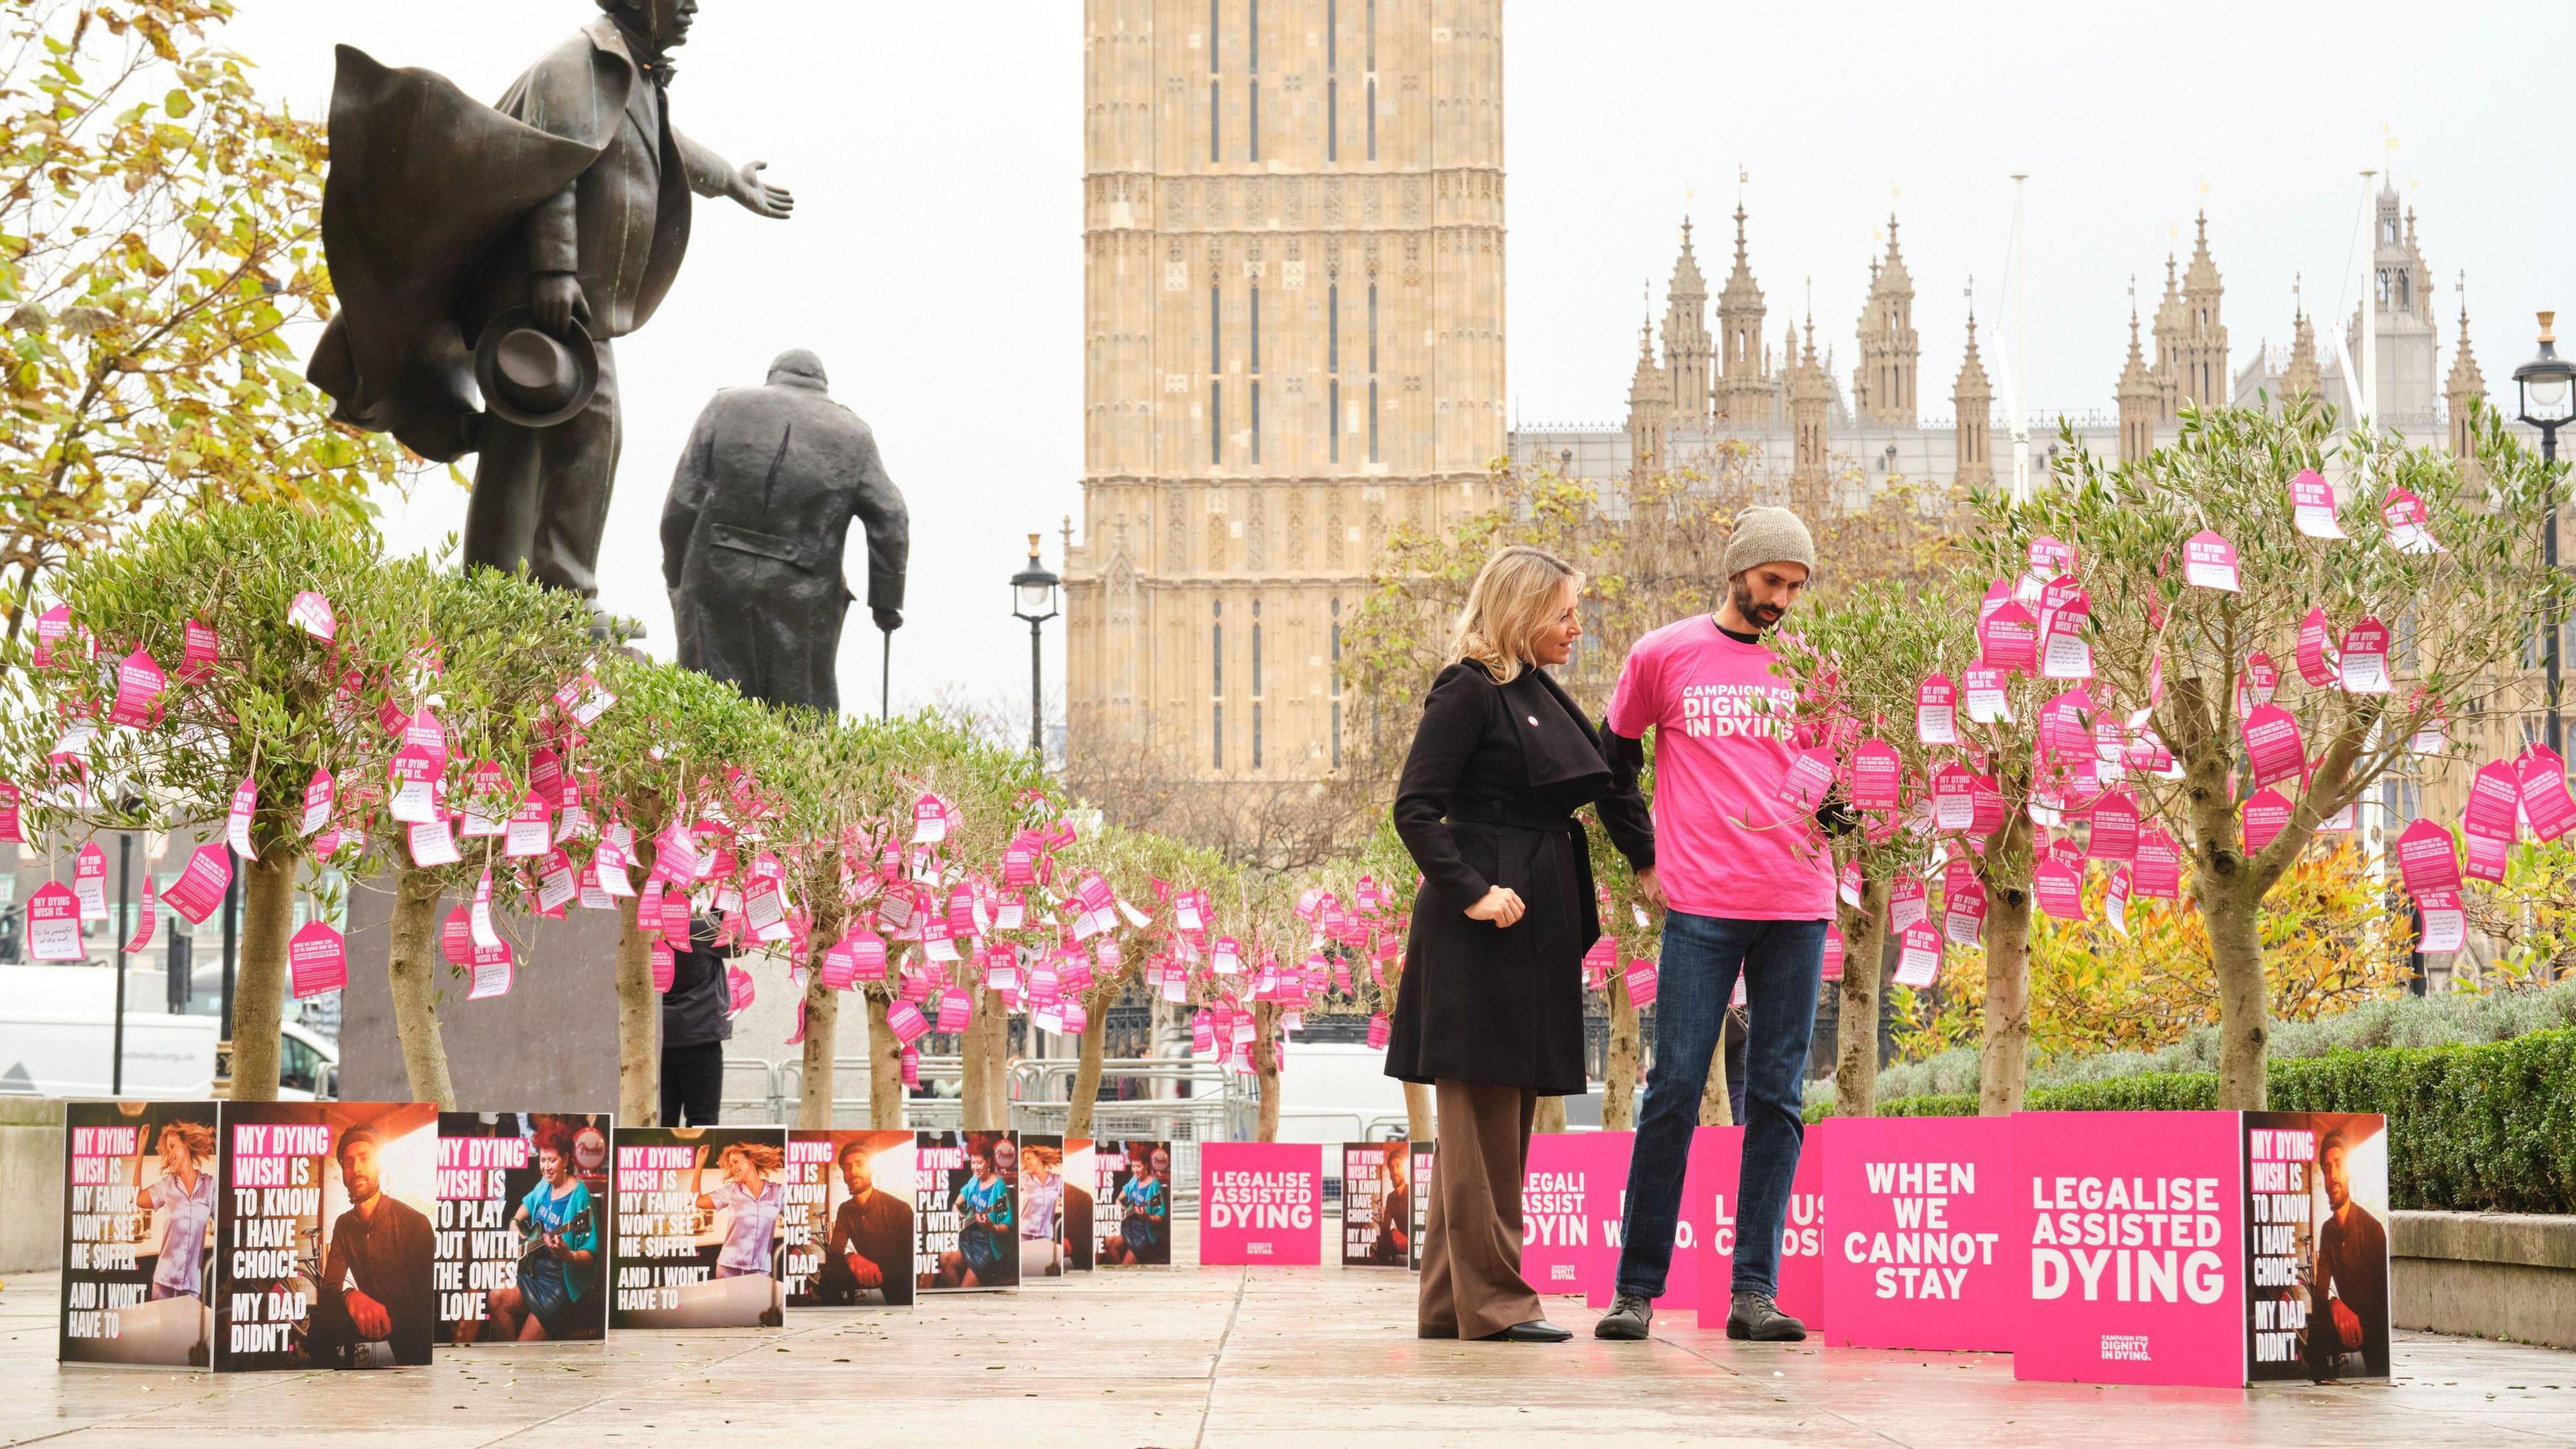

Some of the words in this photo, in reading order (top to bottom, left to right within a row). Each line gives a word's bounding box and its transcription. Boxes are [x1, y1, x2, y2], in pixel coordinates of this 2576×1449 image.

[2190, 543, 2201, 551] MY
[2204, 543, 2226, 554] DYING
[2191, 552, 2210, 561] WISH
[2347, 642, 2365, 651] WISH
[2349, 632, 2361, 641] MY
[2361, 631, 2381, 641] DYING
[1967, 671, 1976, 679] MY
[1978, 671, 1996, 679] DYING
[1683, 685, 1765, 697] CAMPAIGN
[1922, 695, 1937, 703] WISH
[1923, 686, 1931, 694] MY
[1685, 717, 1710, 737] IN
[1939, 784, 1955, 792] WISH
[34, 898, 46, 907] MY
[48, 896, 70, 906] DYING
[34, 907, 54, 917] WISH
[1907, 929, 1917, 938] MY
[1917, 931, 1935, 942] DYING
[1907, 938, 1921, 947] WISH
[74, 1128, 95, 1154] MY
[98, 1129, 134, 1155] DYING
[236, 1126, 267, 1155] MY
[272, 1126, 328, 1155] DYING
[2251, 1130, 2273, 1159] MY
[2276, 1130, 2314, 1161] DYING
[436, 1139, 462, 1167] MY
[469, 1139, 525, 1167] DYING
[620, 1148, 643, 1168] MY
[648, 1147, 691, 1168] DYING
[790, 1142, 832, 1162] DYING
[923, 1148, 962, 1169] DYING
[1348, 1150, 1361, 1165] MY
[1362, 1151, 1384, 1165] DYING
[74, 1157, 105, 1183] WISH
[109, 1157, 121, 1183] IS
[235, 1157, 285, 1185] WISH
[291, 1157, 309, 1185] IS
[619, 1170, 657, 1190] WISH
[663, 1170, 677, 1190] IS
[804, 1163, 818, 1183] IS
[936, 1170, 949, 1189] IS
[1103, 1171, 1114, 1187] IS
[1212, 1171, 1311, 1188] LEGALISE
[1348, 1165, 1368, 1179] WISH
[1369, 1165, 1377, 1179] IS
[1865, 1163, 1975, 1195] WHEN
[2253, 1163, 2286, 1191] WISH
[2290, 1163, 2302, 1191] IS
[436, 1170, 482, 1197] WISH
[488, 1169, 506, 1197] IS
[1348, 1180, 1357, 1193] TO
[1358, 1180, 1381, 1193] KNOW
[73, 1187, 93, 1212] MY
[96, 1186, 140, 1212] FAMILY
[235, 1188, 257, 1216] TO
[263, 1188, 320, 1216] KNOW
[619, 1193, 643, 1213] MY
[647, 1192, 698, 1213] FAMILY
[918, 1191, 950, 1211] PLAY
[1211, 1188, 1311, 1204] ASSISTED
[1348, 1194, 1350, 1208] I
[1352, 1194, 1372, 1208] HAVE
[2033, 1177, 2220, 1212] LEGALISE
[460, 1201, 506, 1228] PLAY
[1210, 1204, 1313, 1229] DYING
[1892, 1197, 1949, 1229] WE
[2253, 1194, 2269, 1222] TO
[2272, 1194, 2310, 1222] KNOW
[72, 1215, 111, 1240] WON'T
[113, 1216, 134, 1240] SEE
[619, 1215, 666, 1235] WON'T
[670, 1214, 694, 1234] SEE
[927, 1212, 959, 1232] WITH
[2032, 1213, 2222, 1247] ASSISTED
[233, 1220, 240, 1247] I
[247, 1220, 296, 1247] HAVE
[926, 1233, 959, 1252] ONES
[1347, 1229, 1360, 1242] MY
[1361, 1229, 1377, 1242] DAD
[2253, 1226, 2259, 1254] I
[2262, 1226, 2296, 1254] HAVE
[471, 1231, 519, 1259] WITH
[618, 1237, 642, 1257] ME
[1844, 1232, 1998, 1265] CANNOT
[71, 1243, 89, 1269] ME
[233, 1250, 302, 1279] CHOICE.
[788, 1254, 818, 1274] DAD
[469, 1261, 517, 1290] ONES
[618, 1267, 650, 1288] AND
[654, 1267, 660, 1287] I
[663, 1267, 710, 1287] WON'T
[2031, 1248, 2224, 1305] DYING
[2254, 1258, 2302, 1287] CHOICE.
[1875, 1268, 1969, 1300] STAY
[69, 1283, 97, 1308] AND
[99, 1284, 104, 1309] I
[107, 1284, 147, 1309] WON'T
[232, 1293, 263, 1321] MY
[268, 1292, 307, 1320] DAD
[618, 1289, 656, 1310] HAVE
[68, 1311, 101, 1337] HAVE
[2255, 1301, 2276, 1330] MY
[2279, 1300, 2306, 1330] DAD
[231, 1324, 294, 1353] DIDN'T.
[2101, 1341, 2148, 1350] DIGNITY
[2256, 1333, 2299, 1362] DIDN'T.
[2102, 1351, 2113, 1359] IN
[2114, 1351, 2151, 1360] DYING.
